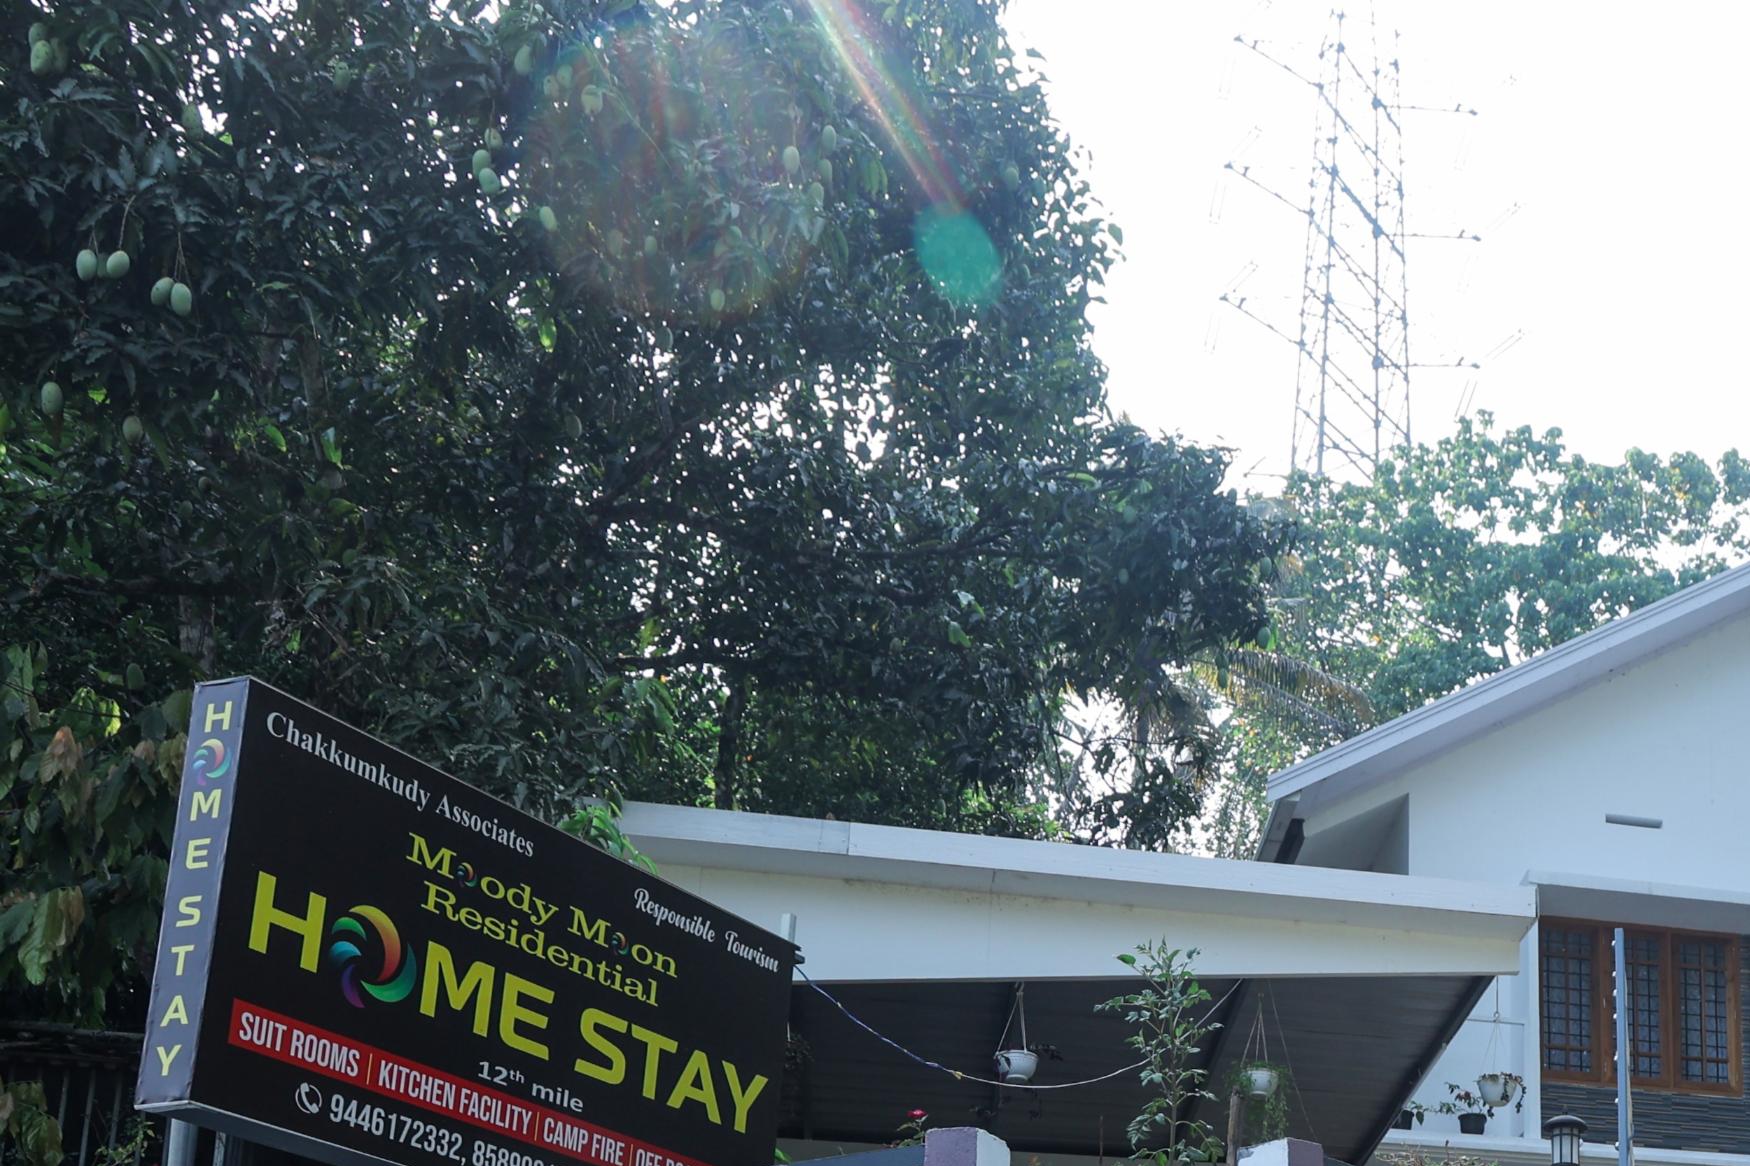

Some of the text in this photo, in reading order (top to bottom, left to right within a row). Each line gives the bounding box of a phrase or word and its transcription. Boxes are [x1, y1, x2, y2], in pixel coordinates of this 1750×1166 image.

[266, 711, 535, 858] Chakkumkudy Associates
[405, 831, 679, 979] Moody Moon
[420, 880, 659, 1007] Residential
[633, 887, 780, 974] Responsible Tourism
[157, 895, 205, 1077] STAY
[247, 870, 769, 1135] HOME STAY
[238, 1011, 288, 1052] SUIT
[290, 1028, 361, 1078] ROOMS
[378, 1059, 457, 1111] KITCHEN
[459, 1087, 533, 1135] FACILITY
[543, 1117, 589, 1154] CAMP
[591, 1132, 626, 1166] FIRE
[329, 1093, 467, 1166] 9446172332,
[477, 1060, 585, 1114] 12th mile
